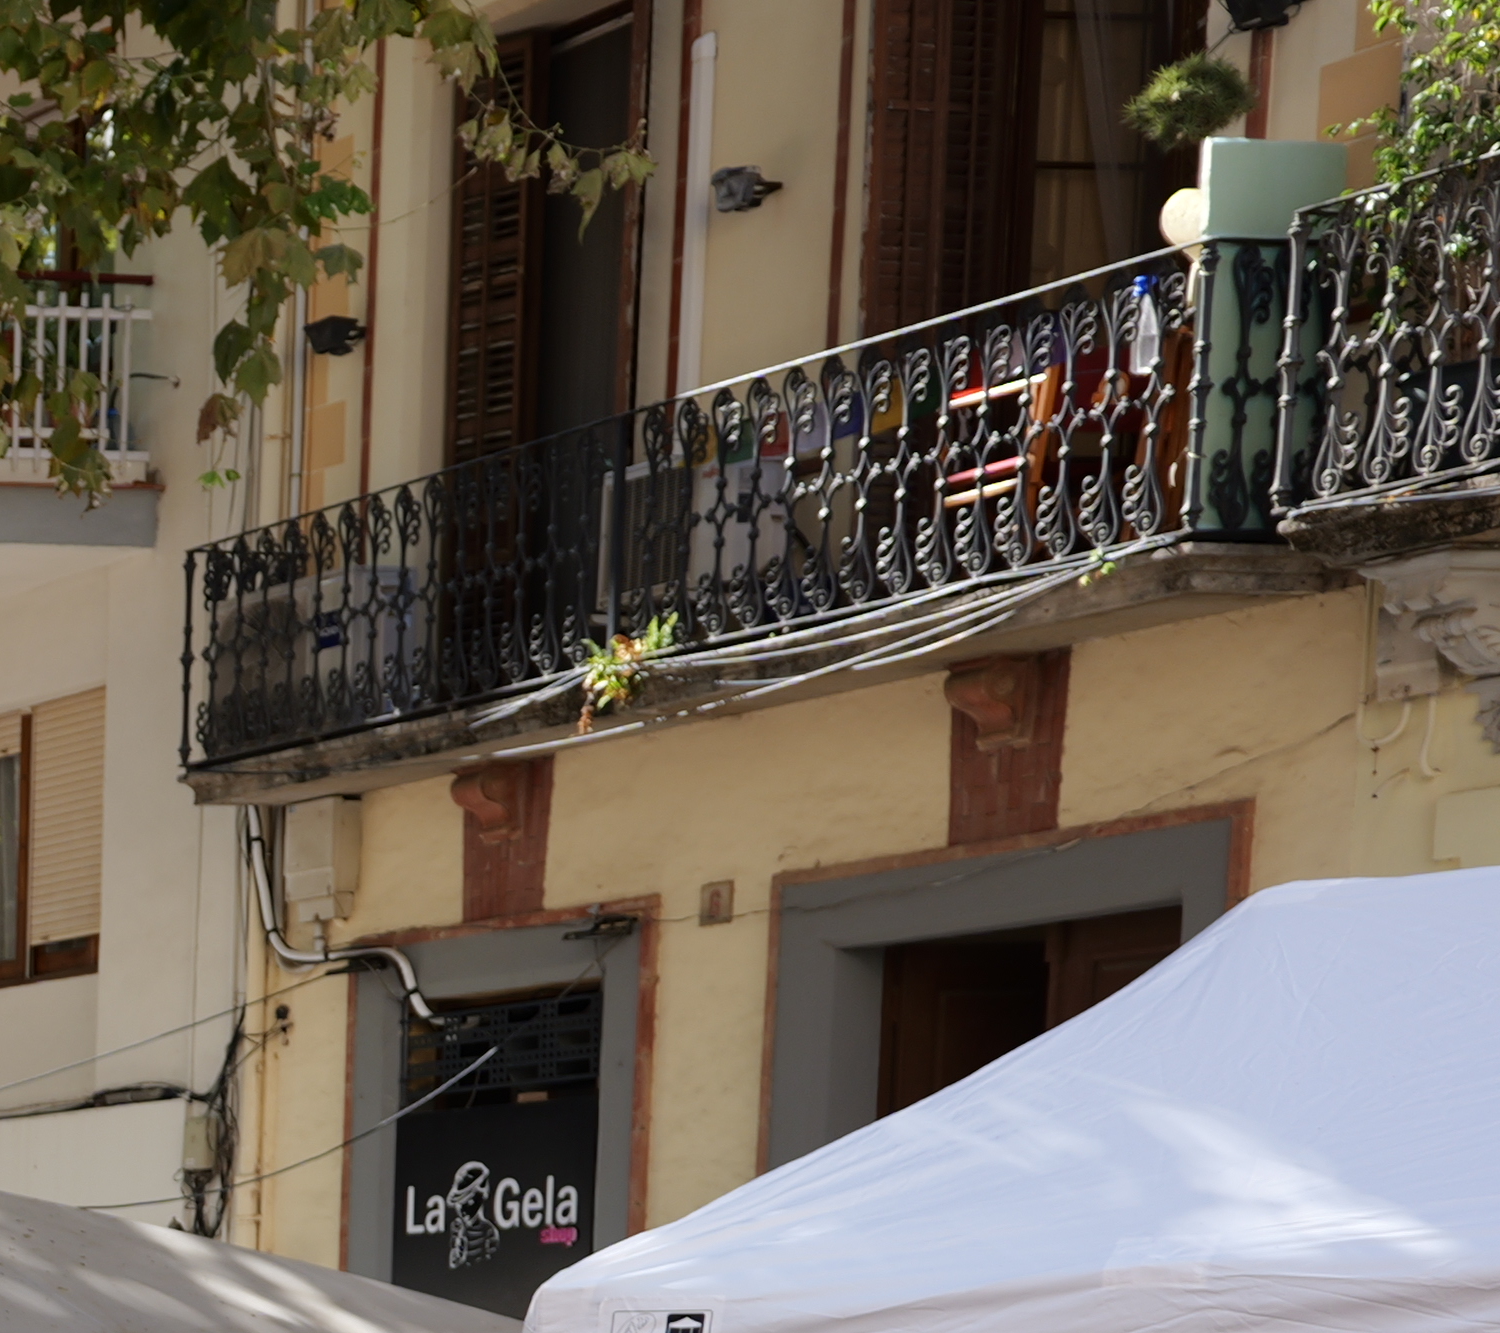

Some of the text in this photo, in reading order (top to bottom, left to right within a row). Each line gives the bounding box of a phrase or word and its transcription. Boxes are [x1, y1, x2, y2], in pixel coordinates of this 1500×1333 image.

[406, 1174, 578, 1234] La Gela
[540, 1224, 578, 1247] shop
